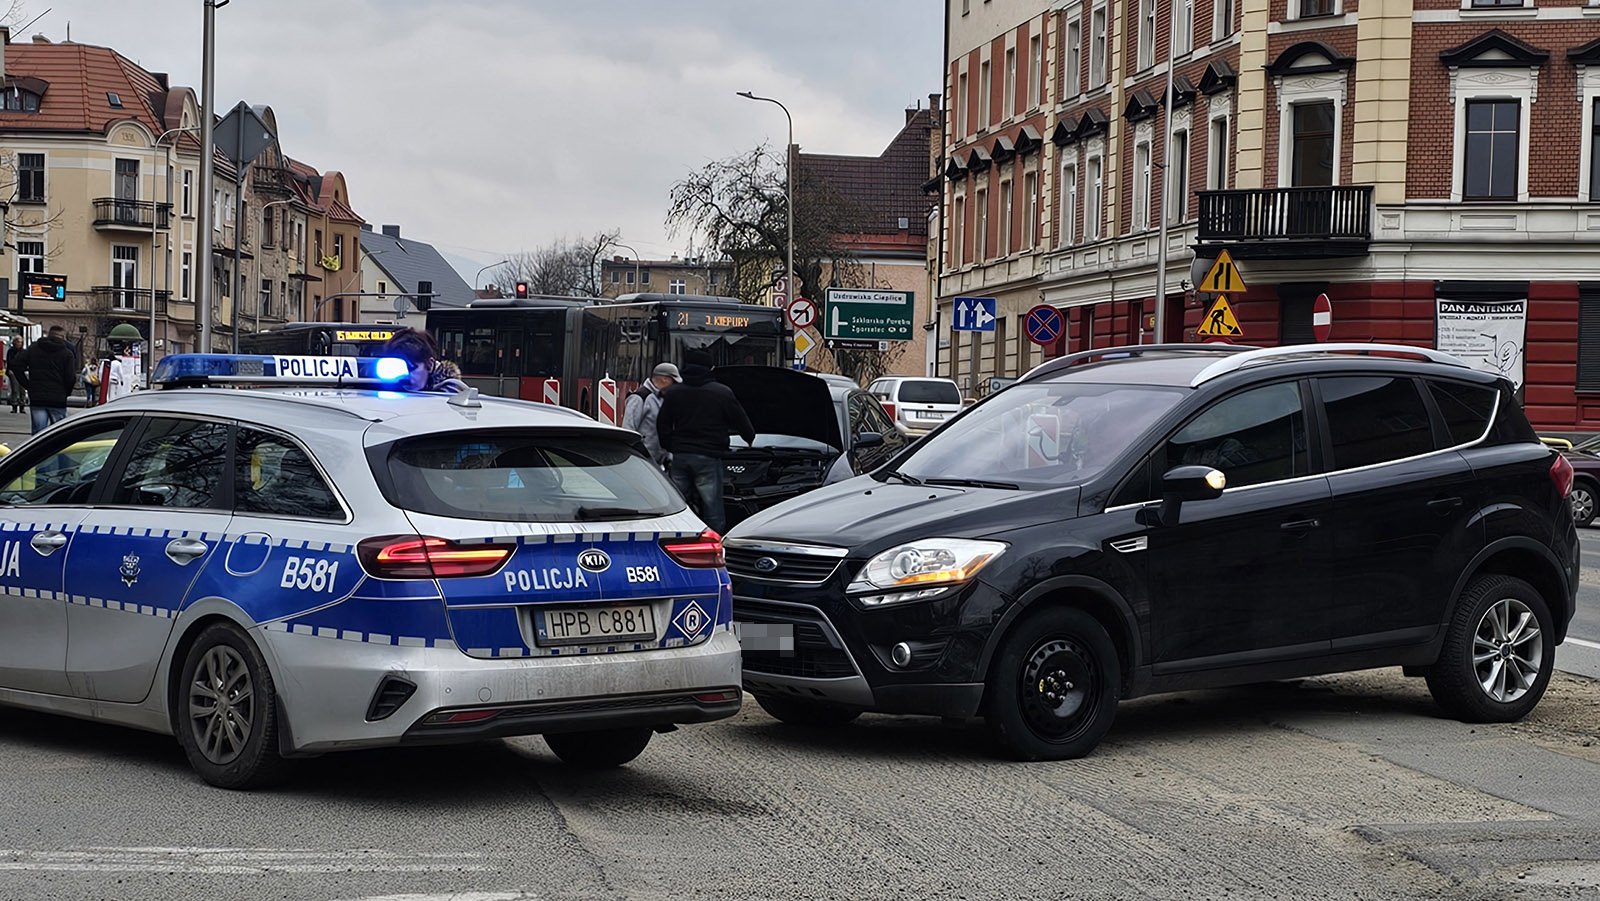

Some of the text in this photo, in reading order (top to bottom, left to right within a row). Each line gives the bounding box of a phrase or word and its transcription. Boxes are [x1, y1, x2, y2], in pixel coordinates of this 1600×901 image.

[873, 293, 903, 302] Cieplice
[1441, 303, 1522, 313] PAN ANTENKA
[677, 312, 689, 326] 21
[279, 358, 354, 378] POLICJA
[0, 540, 20, 578] JA
[585, 554, 606, 566] KIA
[281, 556, 339, 593] B581
[504, 567, 588, 592] POLICJA
[626, 566, 660, 583] B581
[550, 608, 647, 638] HPB C881
[688, 614, 698, 627] R
